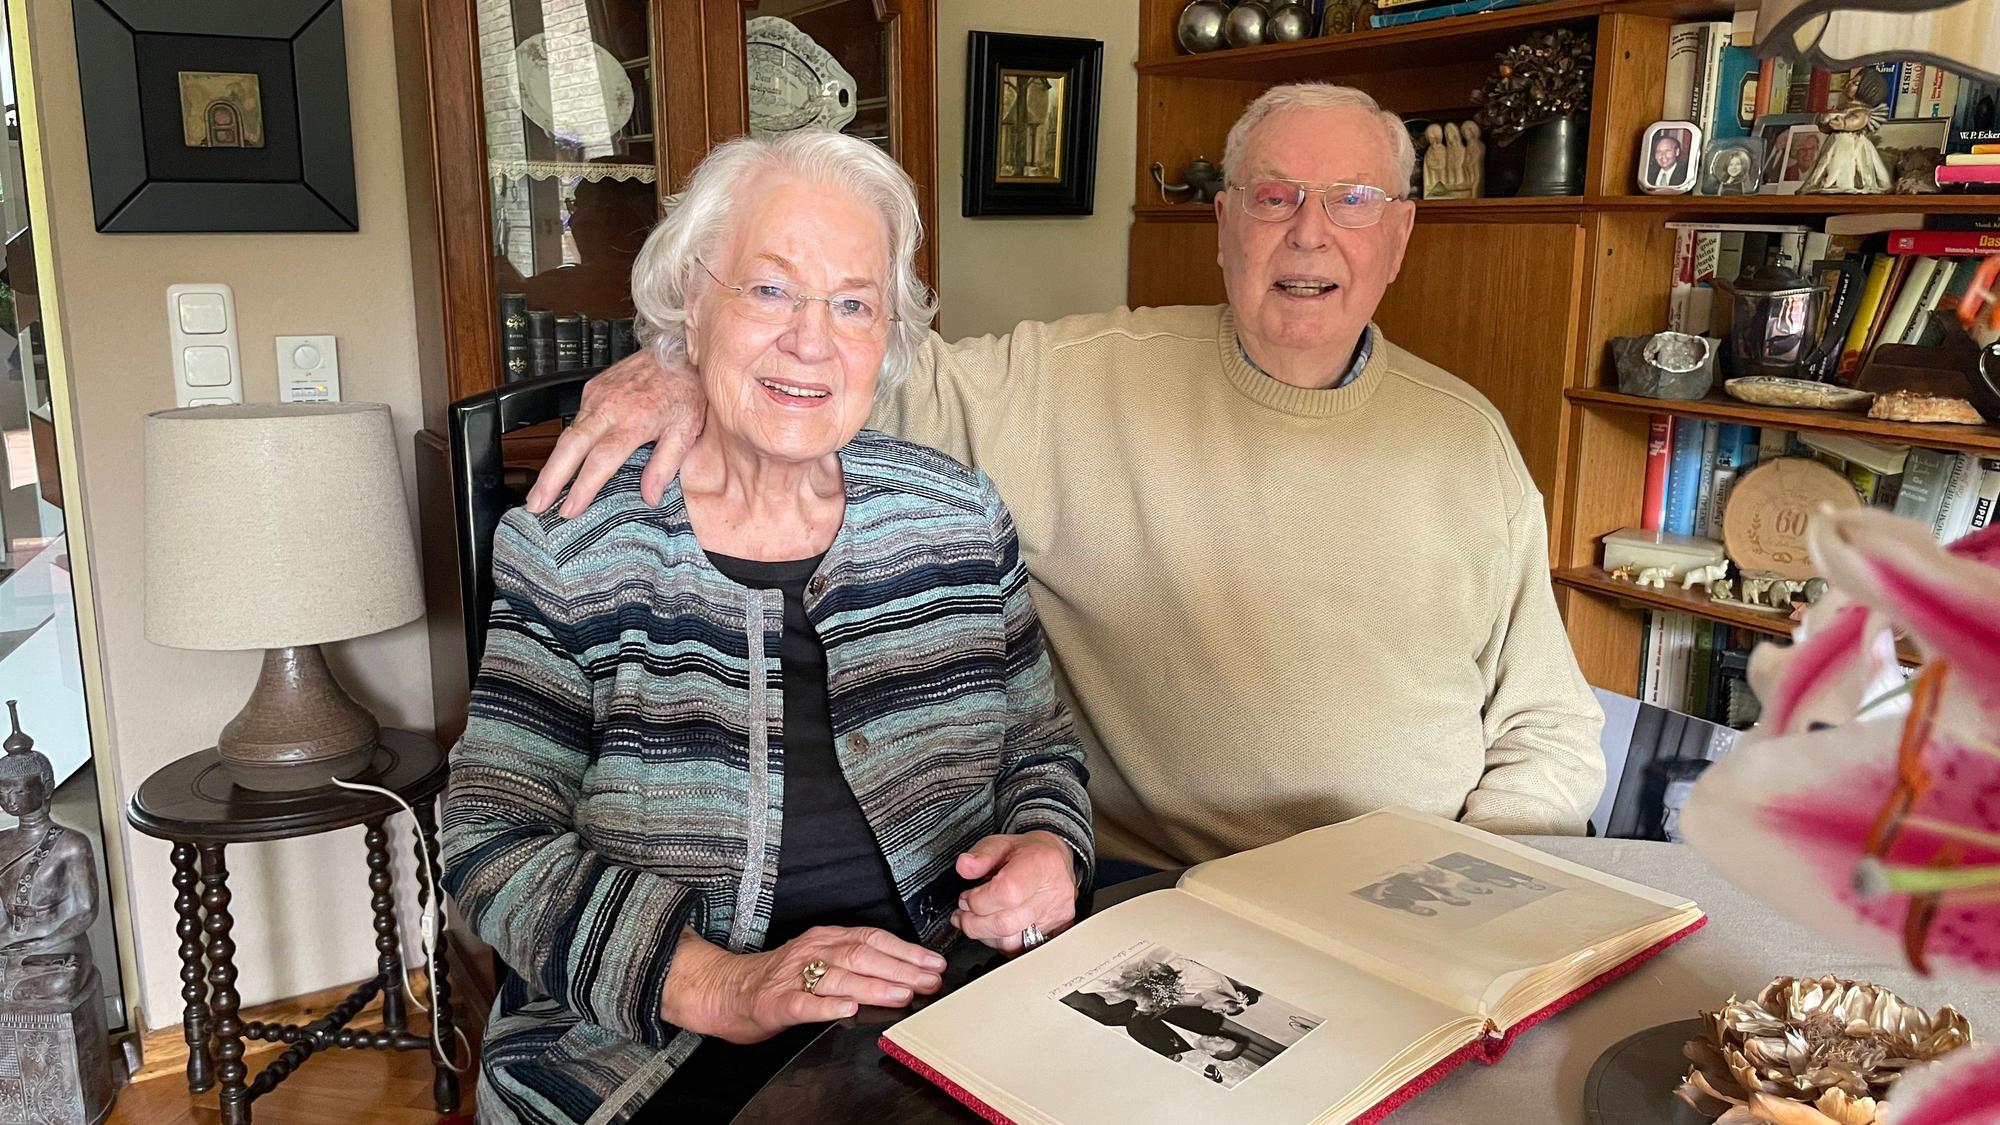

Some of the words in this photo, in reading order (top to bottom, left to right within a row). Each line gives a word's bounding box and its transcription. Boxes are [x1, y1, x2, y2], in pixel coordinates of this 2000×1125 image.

[1979, 235, 2000, 246] Das
[1776, 510, 1808, 536] 60
[1974, 500, 1990, 527] PIPER
